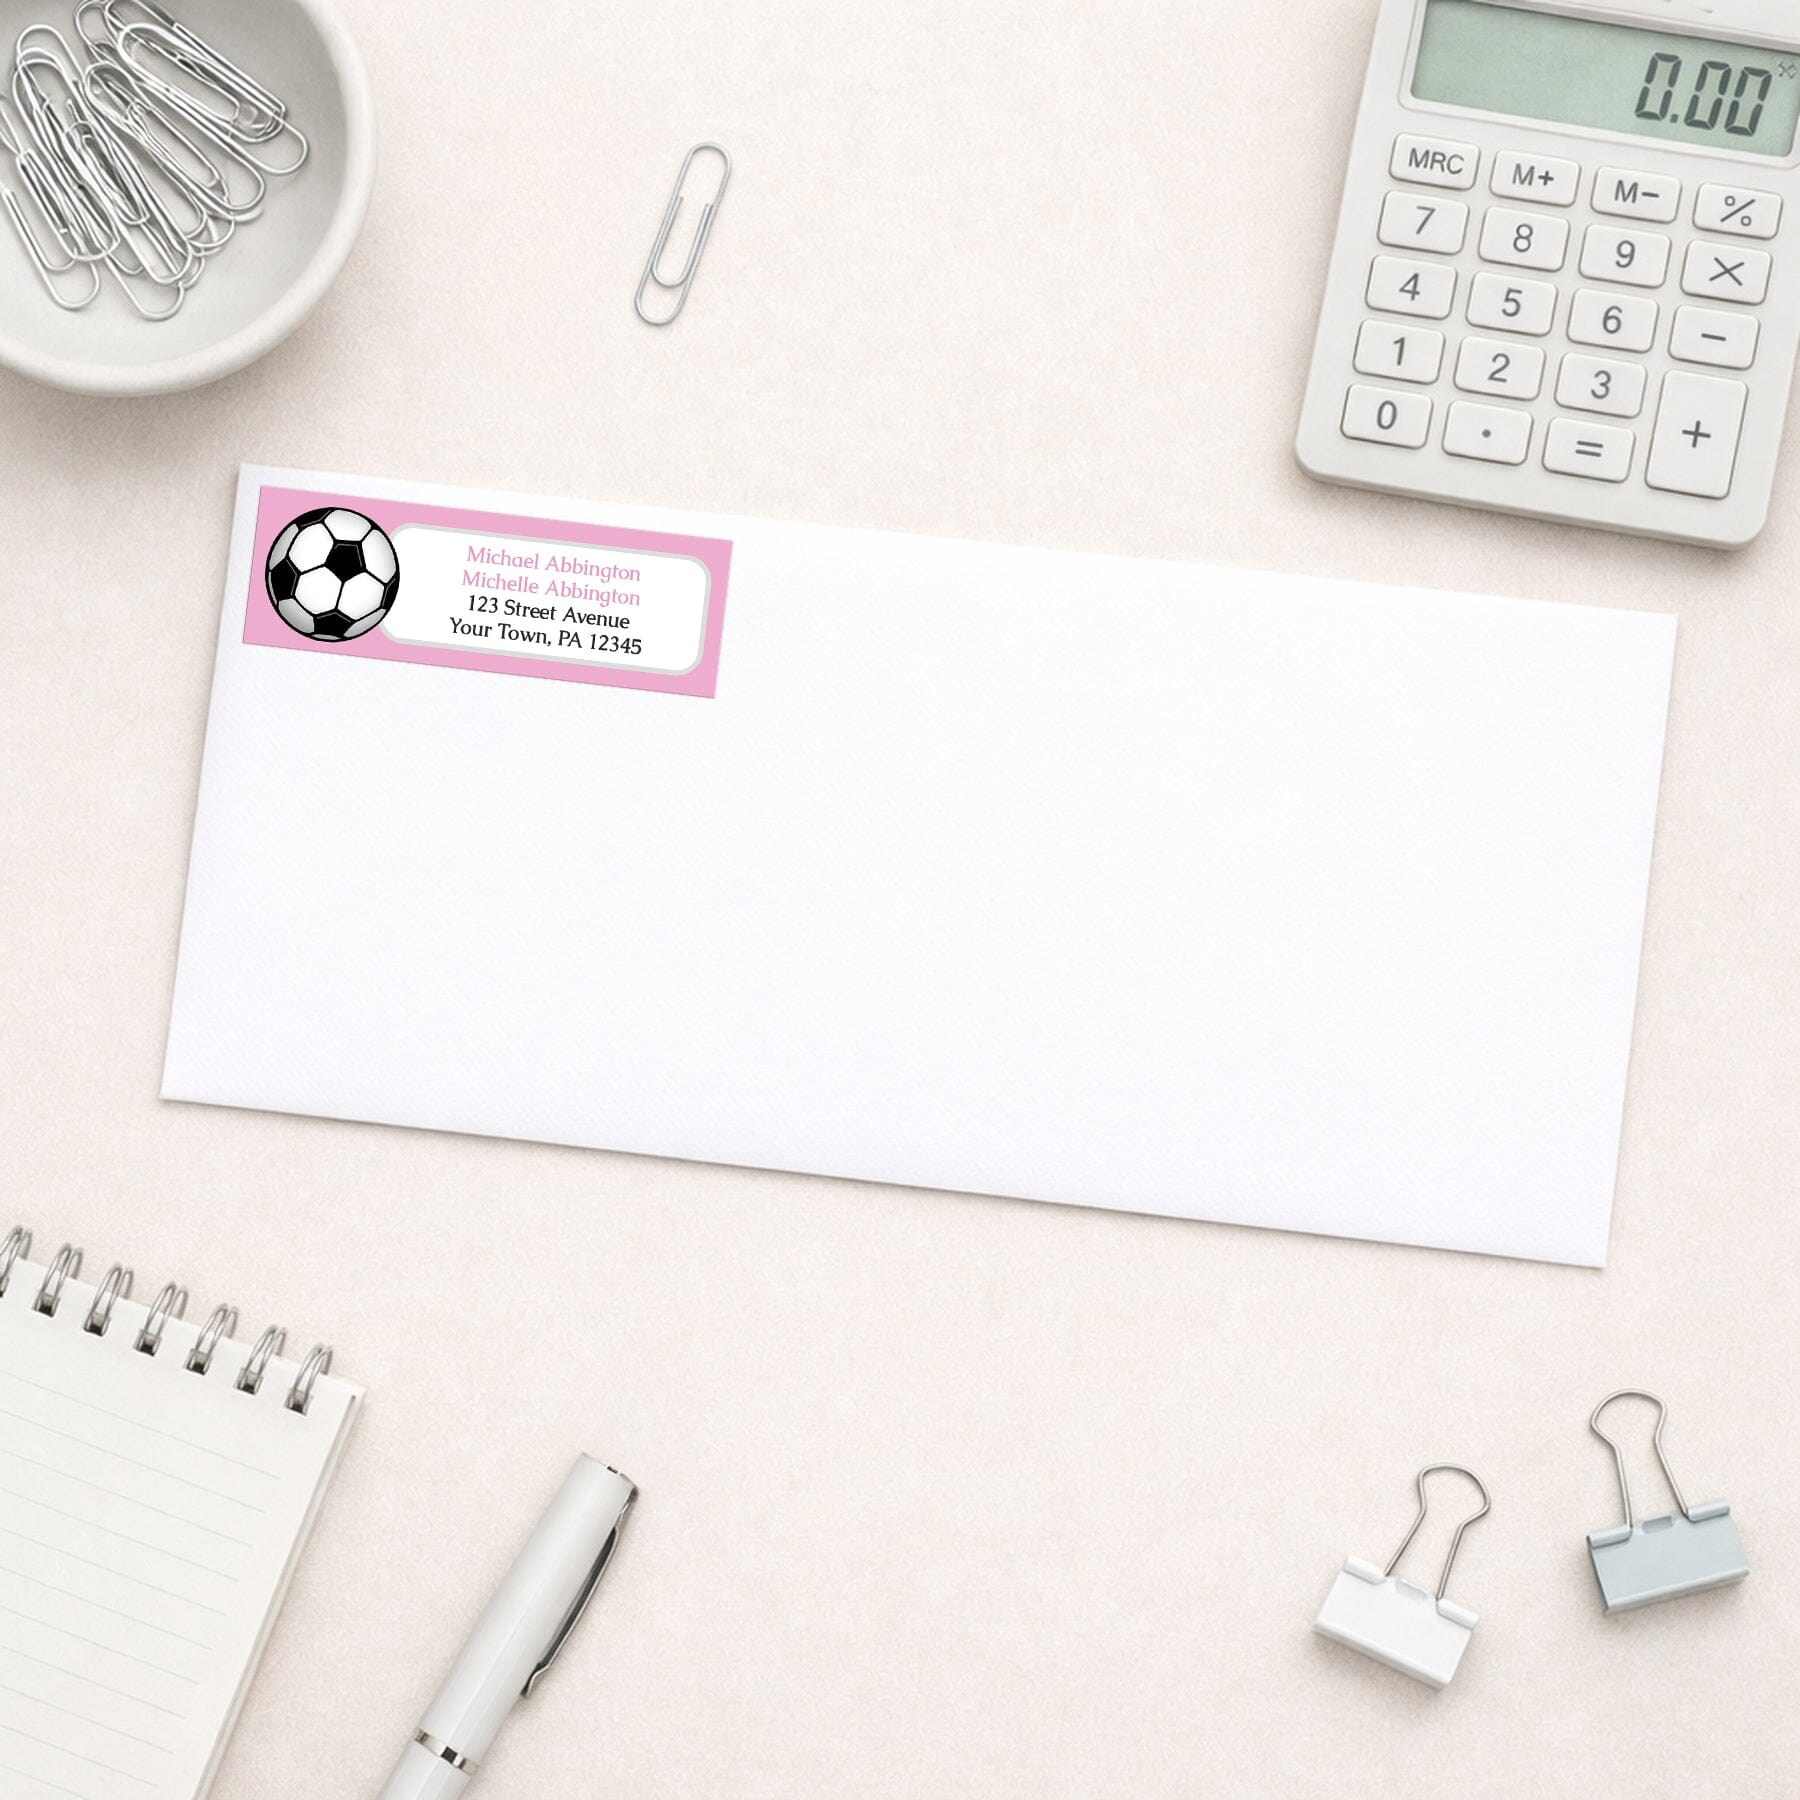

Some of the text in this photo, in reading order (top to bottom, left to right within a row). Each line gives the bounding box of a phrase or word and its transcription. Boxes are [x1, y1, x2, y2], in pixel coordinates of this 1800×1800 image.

[1635, 52, 1773, 137] 0.00
[1408, 148, 1464, 175] MRC
[1512, 163, 1554, 187] M+
[1415, 206, 1435, 234] 7
[1513, 224, 1533, 252] 8
[1615, 240, 1636, 268] 9
[1400, 272, 1420, 301] 4
[1502, 288, 1522, 317] 5
[1602, 305, 1622, 334] 6
[1392, 336, 1406, 366] 1
[1488, 353, 1510, 382] 2
[1590, 370, 1612, 399] 3
[1376, 401, 1397, 430] 0
[467, 545, 641, 583] Michael Abbington
[462, 570, 641, 607] Michelle Abbington
[468, 594, 630, 629] 123 Street Avenue
[450, 617, 642, 655] Your Town, PA 12345
